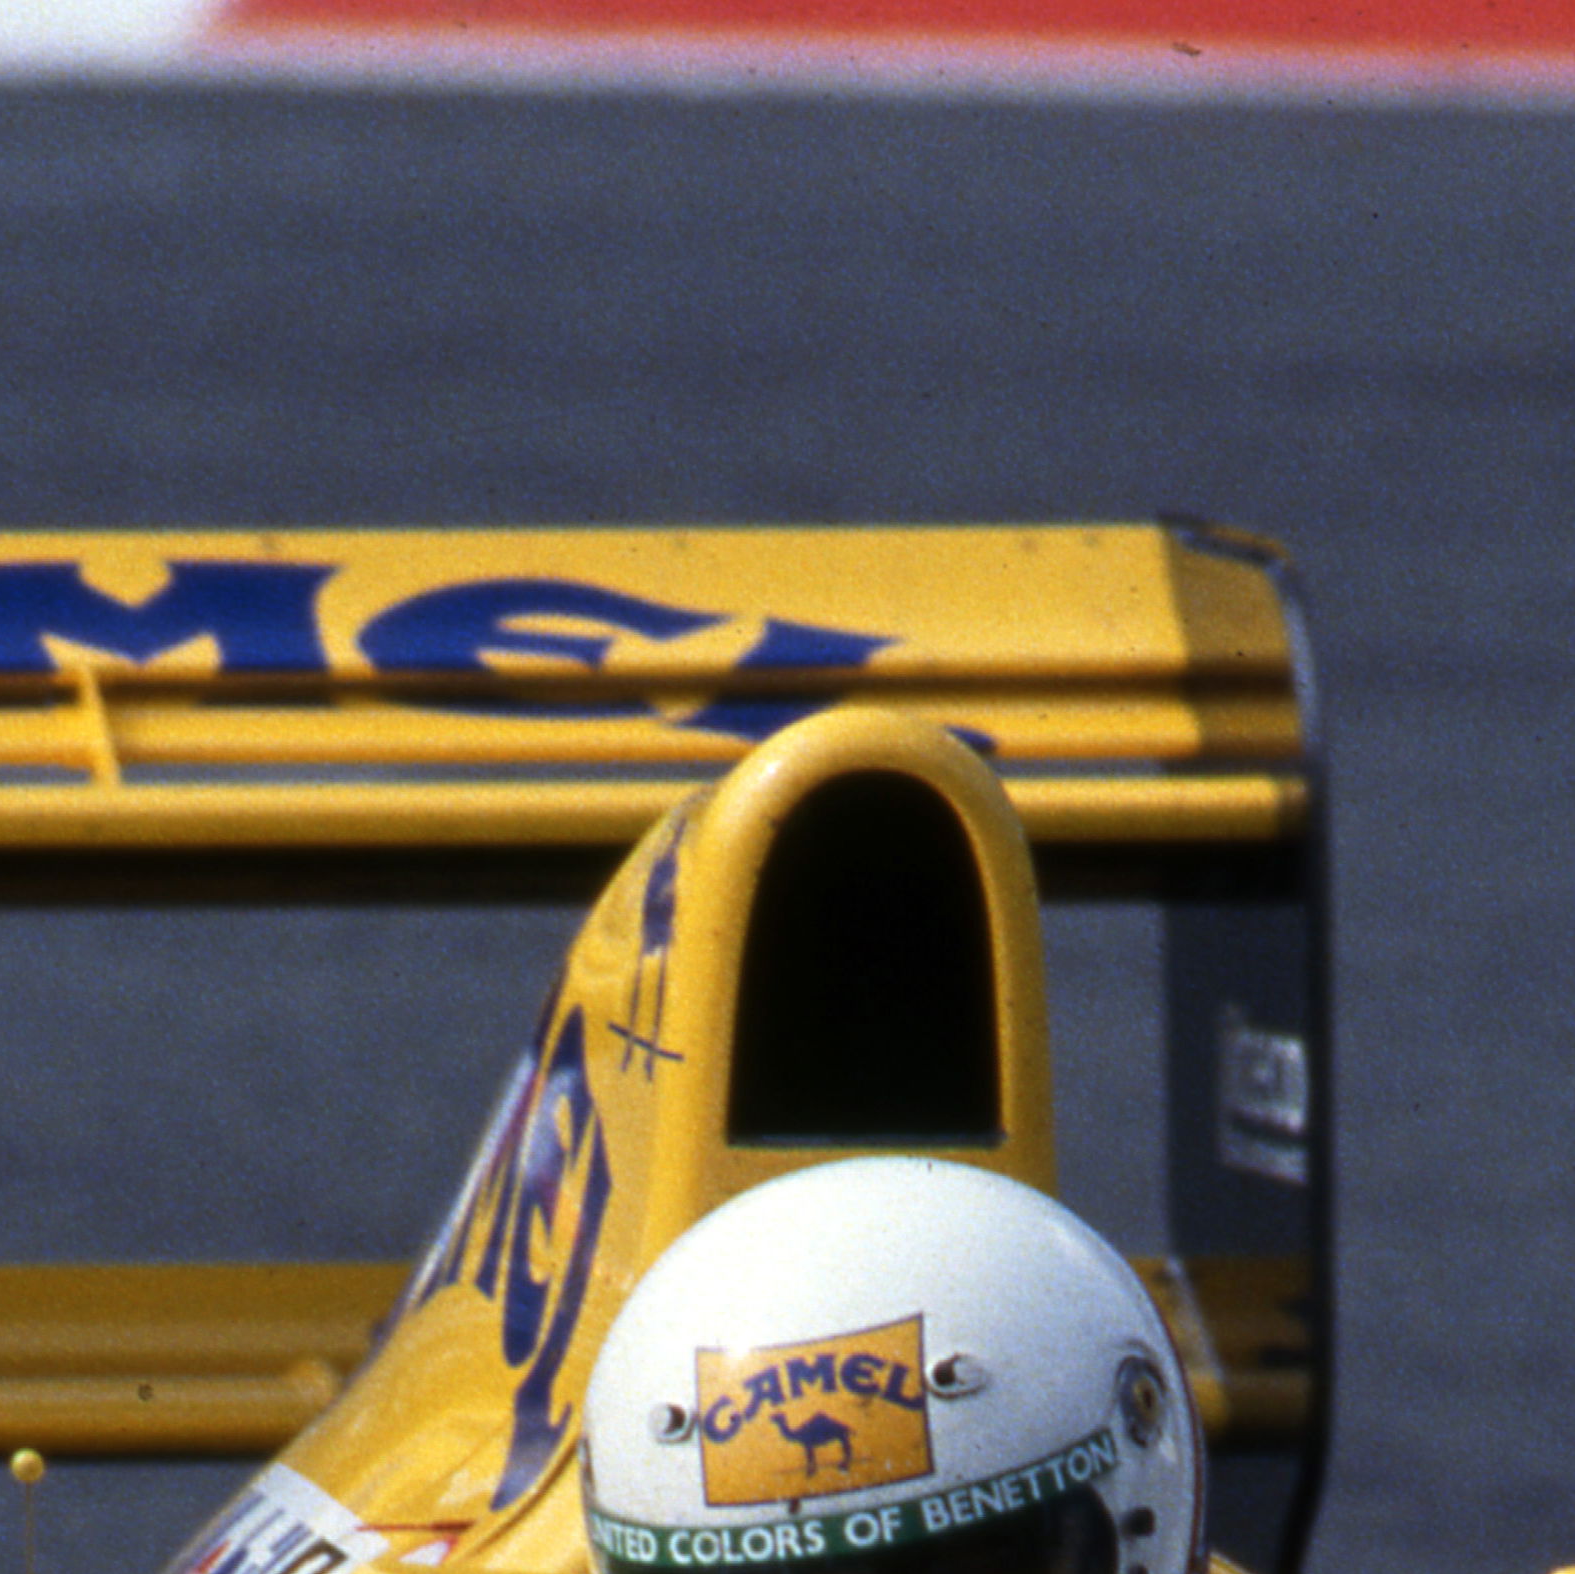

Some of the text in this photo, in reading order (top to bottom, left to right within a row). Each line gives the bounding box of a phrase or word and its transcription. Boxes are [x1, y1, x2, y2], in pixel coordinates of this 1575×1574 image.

[702, 1352, 925, 1443] CAMEL
[668, 1520, 825, 1564] COLORS
[845, 1508, 902, 1546] OF
[924, 1433, 1117, 1530] BENETTON
